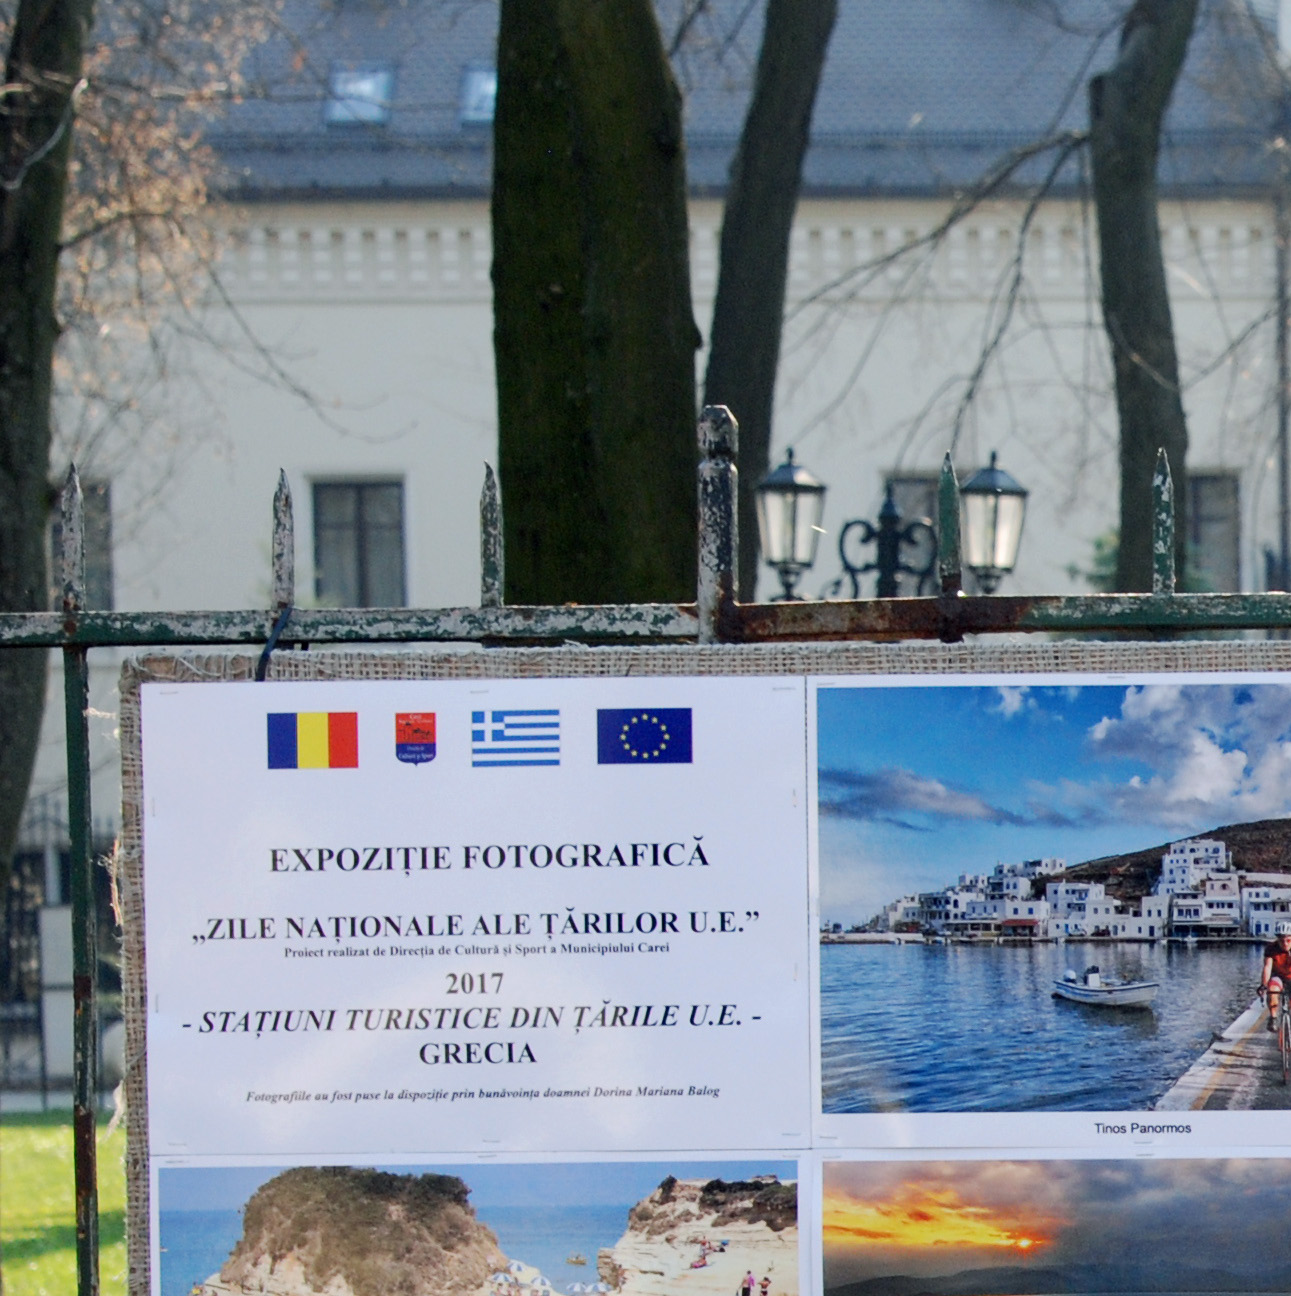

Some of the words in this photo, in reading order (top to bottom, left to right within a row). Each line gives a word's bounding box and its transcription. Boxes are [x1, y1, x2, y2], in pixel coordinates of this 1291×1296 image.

[270, 845, 451, 877] EXPOZIȚIE
[463, 835, 710, 870] FOTOGRAFICĂ
[285, 915, 463, 940] NAȚIONALE
[471, 913, 531, 936] ALE
[541, 906, 680, 940] ȚĂRILOR
[284, 947, 324, 958] Proiect
[328, 946, 369, 957] realizat
[373, 946, 386, 956] de
[438, 945, 451, 955] de
[455, 944, 499, 955] Cultură
[515, 943, 546, 957] Sport
[560, 942, 634, 956] Municipiului
[638, 942, 670, 953] Carei
[446, 972, 504, 995] 2017
[199, 1010, 337, 1039] STAȚIUNI
[347, 1007, 500, 1031] TURISTICE
[511, 1006, 565, 1029] DIN
[574, 1000, 678, 1034] ȚĂRILE
[689, 1004, 742, 1027] U.E.
[419, 1041, 537, 1066] GRECIA
[246, 1091, 311, 1105] Fotografiile
[314, 1093, 328, 1101] au
[330, 1090, 352, 1104] fost
[354, 1092, 381, 1104] puse
[384, 1090, 394, 1100] la
[451, 1089, 475, 1102] prin
[543, 1087, 590, 1098] doamnei
[593, 1086, 632, 1097] Dorina
[635, 1086, 684, 1097] Mariana
[687, 1085, 720, 1098] Balog
[1094, 1122, 1127, 1134] Tinos
[1130, 1122, 1192, 1134] Panormos
